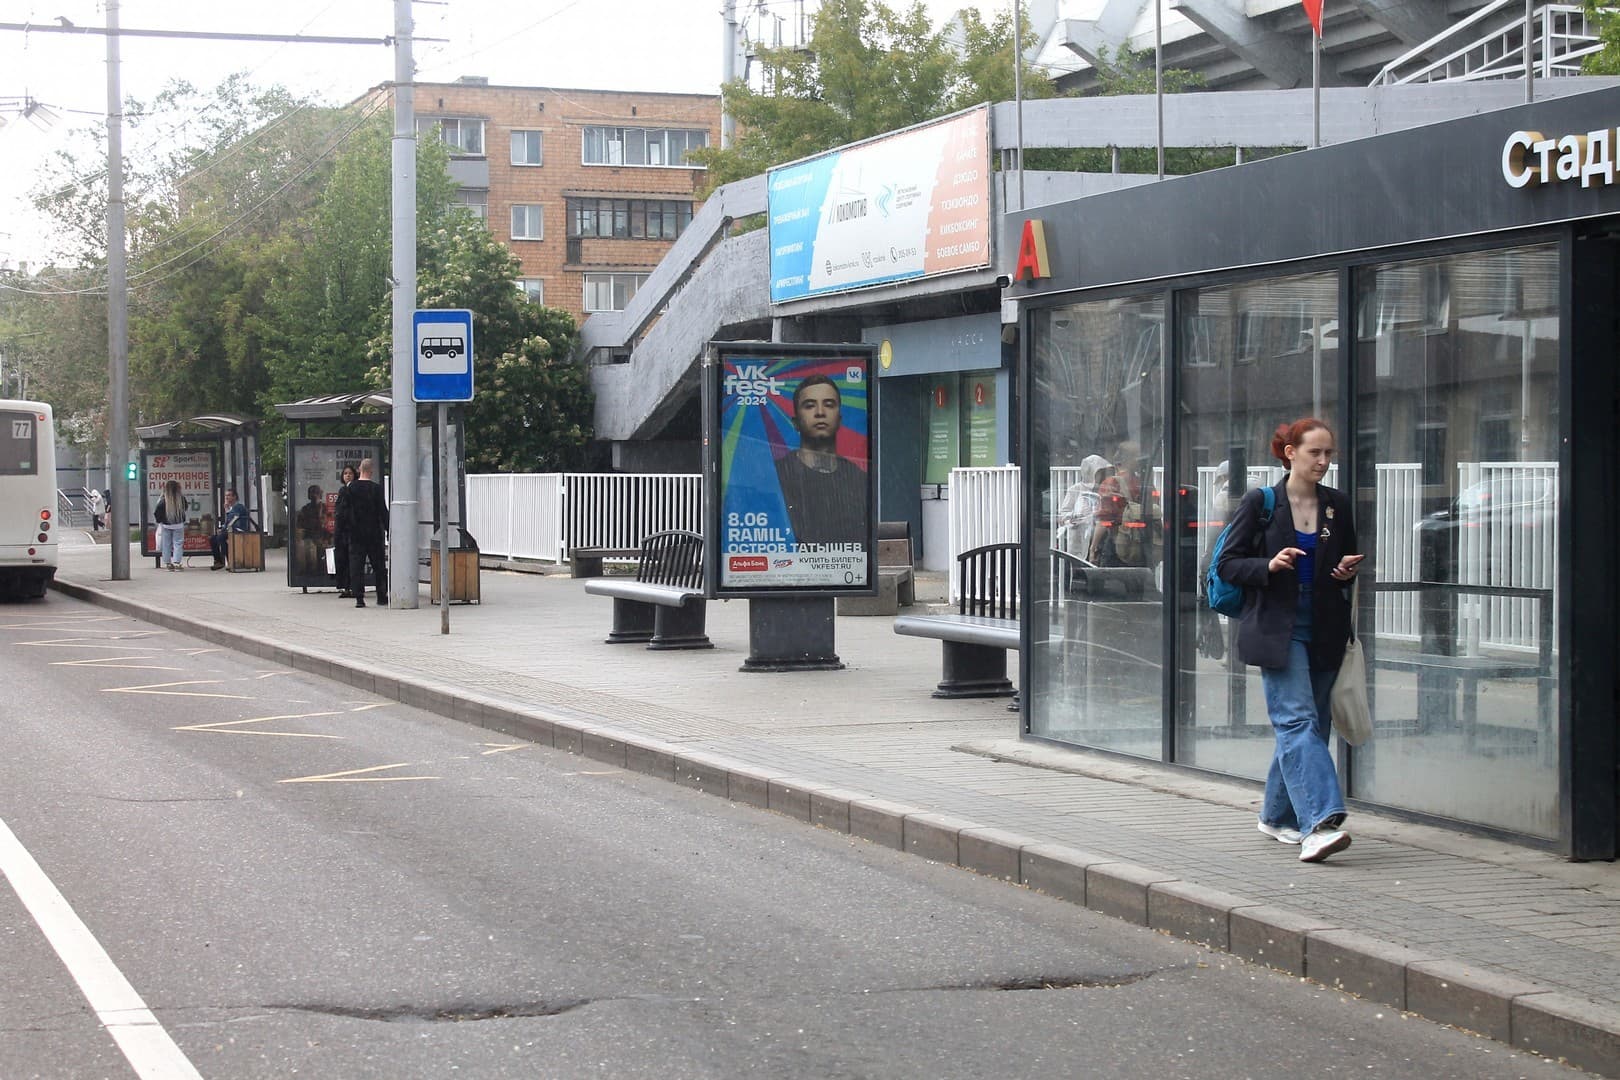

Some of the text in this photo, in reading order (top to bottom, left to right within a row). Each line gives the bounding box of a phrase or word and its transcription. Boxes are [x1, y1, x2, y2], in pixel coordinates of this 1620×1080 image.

[1502, 127, 1620, 188] Стад
[936, 240, 980, 258] БОЕВОЕ САМБО
[736, 365, 768, 380] VK
[724, 375, 785, 395] fest
[737, 396, 767, 406] 2024
[15, 423, 29, 437] 77
[149, 472, 209, 480] СПОРТИВНОЕ
[149, 481, 210, 489] ПИНИЕ
[728, 512, 768, 527] 8.06
[728, 528, 791, 542] RAMIL'
[728, 543, 862, 553] ОСТРОВ ТАТЫШЕВ
[844, 571, 863, 584] 0+
